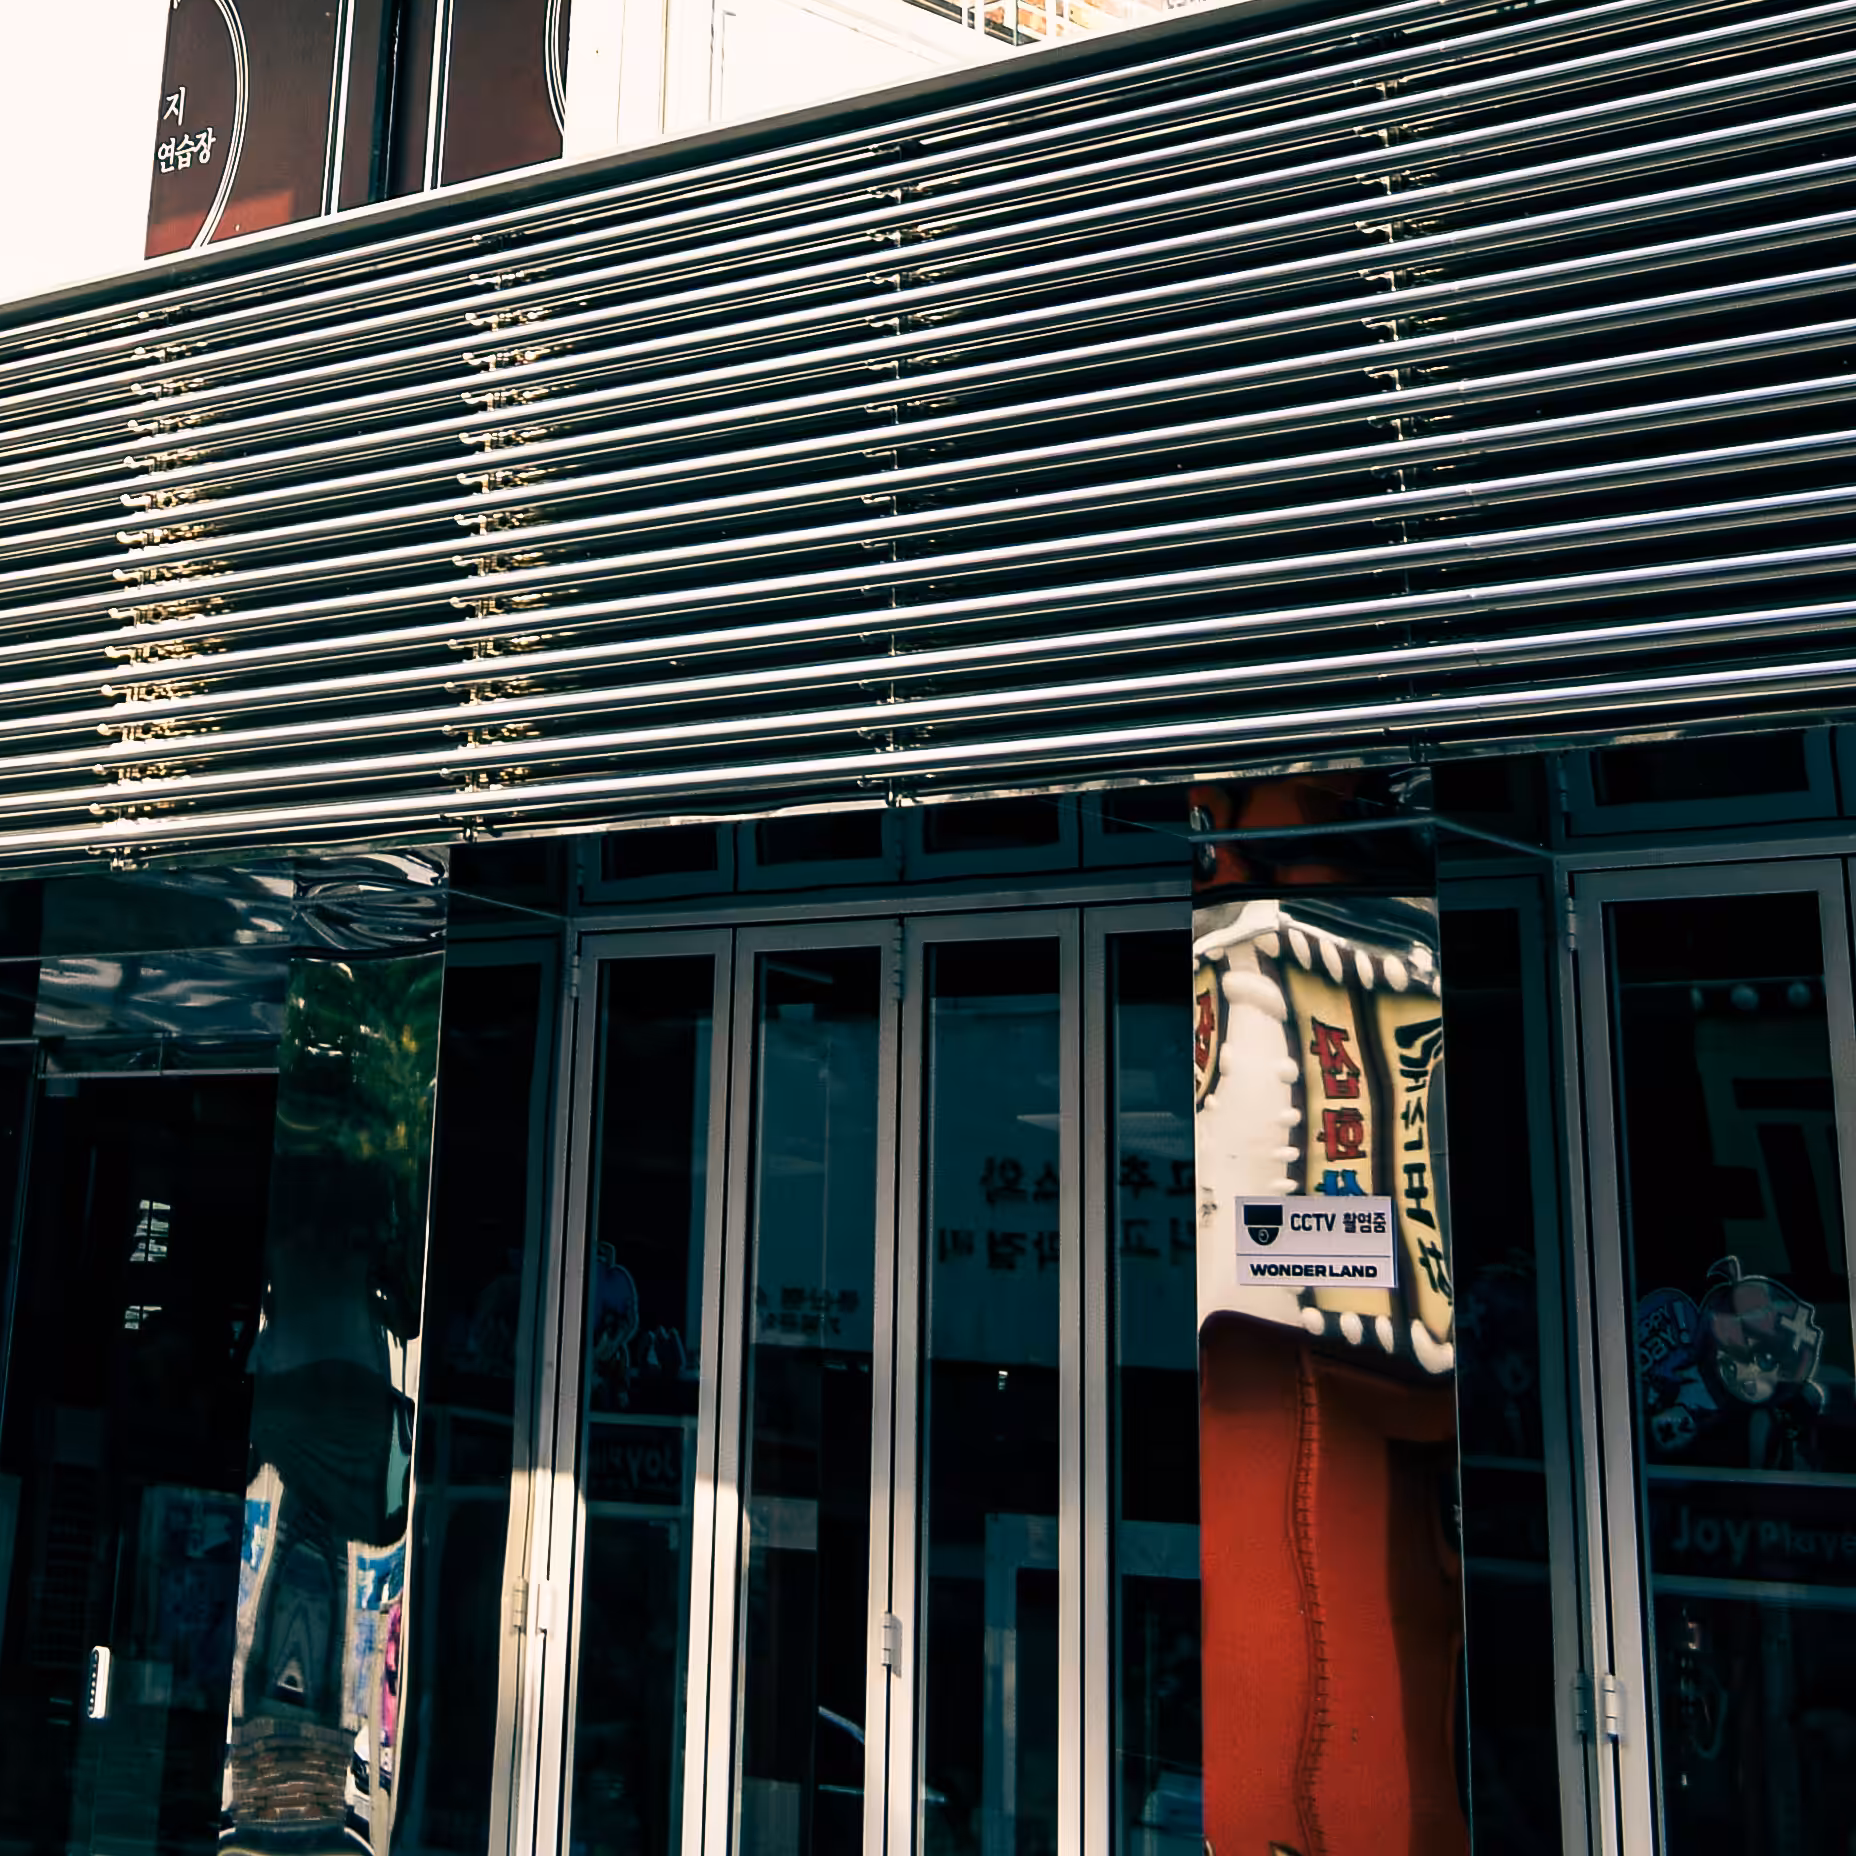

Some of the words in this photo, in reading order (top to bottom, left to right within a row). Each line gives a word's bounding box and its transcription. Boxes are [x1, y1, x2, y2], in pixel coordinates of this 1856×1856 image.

[158, 127, 217, 174] 연습장
[1290, 1213, 1336, 1232] CCTV
[1343, 1212, 1386, 1233] 촬영중
[1250, 1263, 1378, 1278] WONDERLAND
